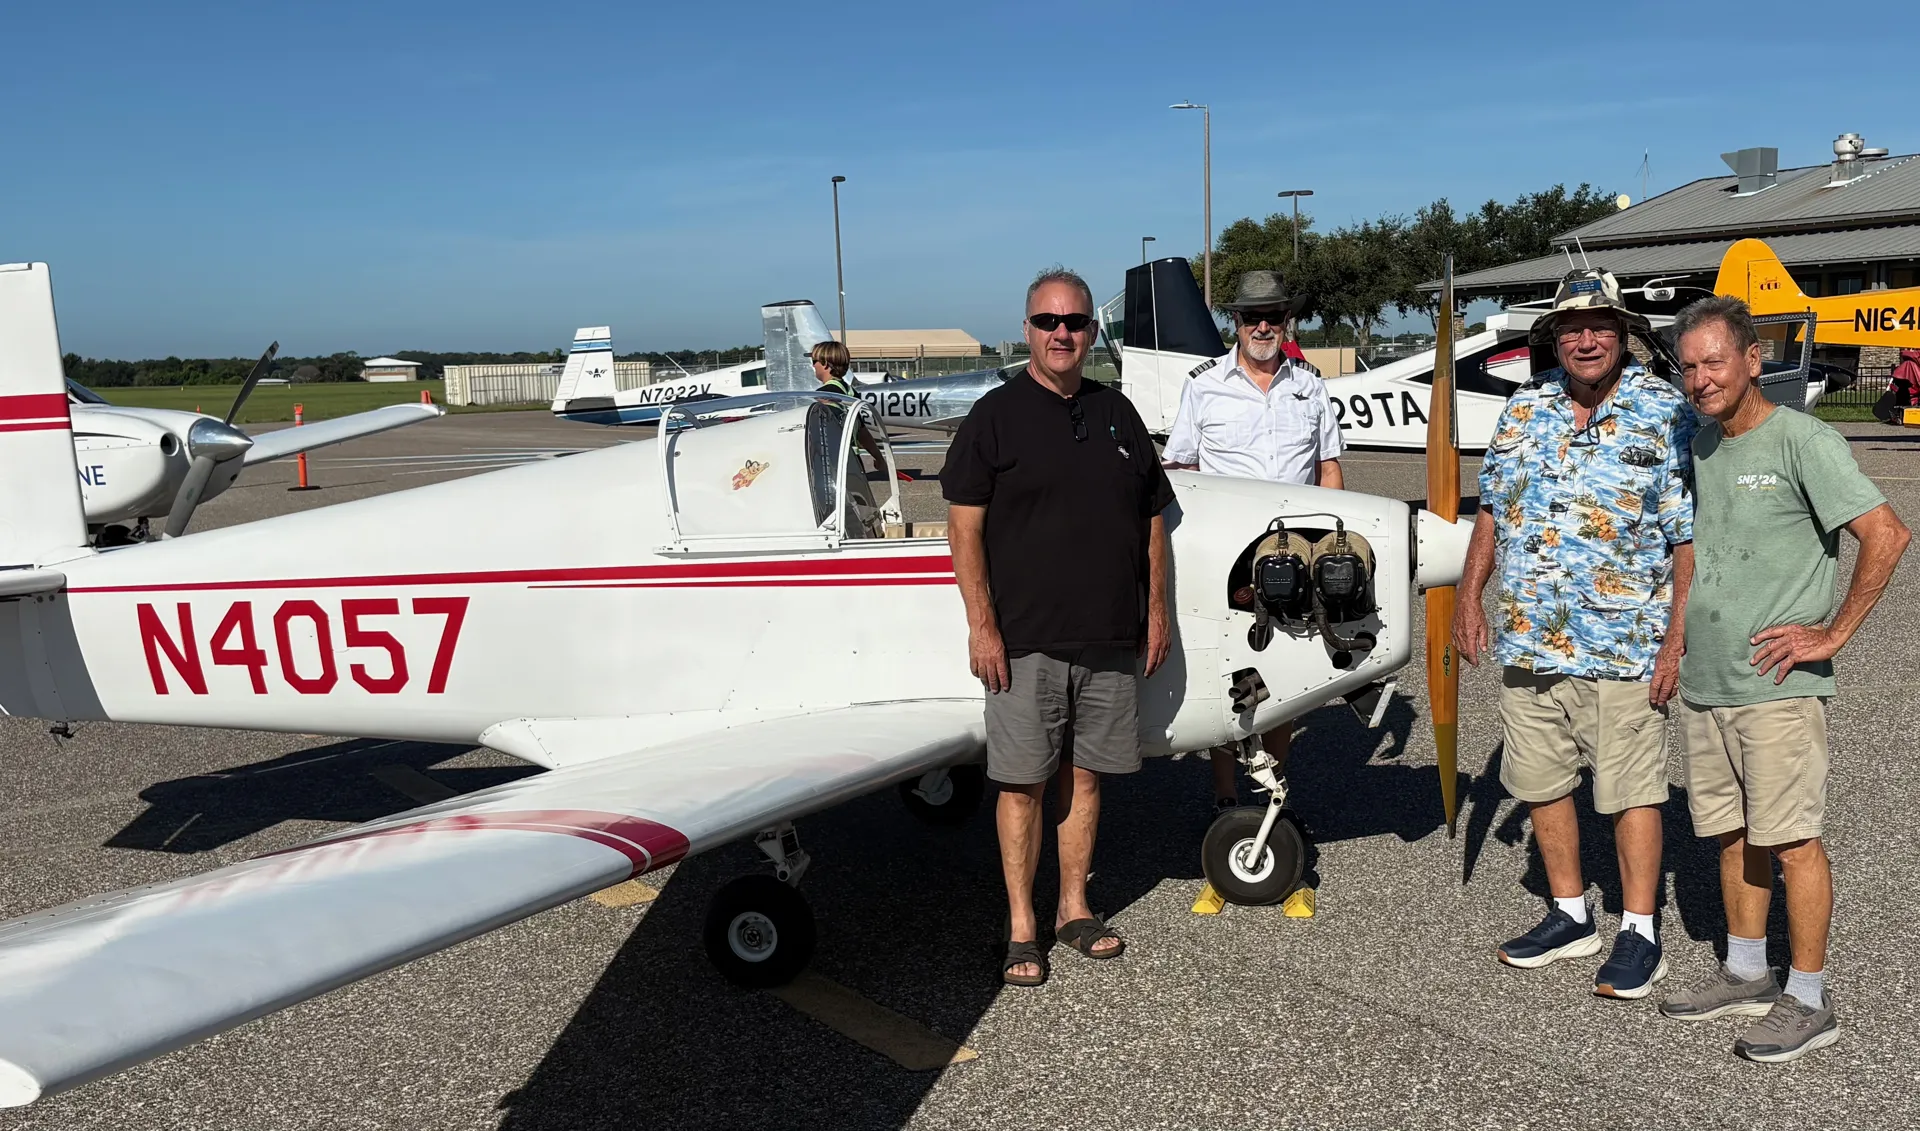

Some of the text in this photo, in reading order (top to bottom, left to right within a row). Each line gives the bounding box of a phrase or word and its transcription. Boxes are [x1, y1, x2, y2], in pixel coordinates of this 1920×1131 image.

[1854, 306, 1920, 332] N164
[640, 383, 711, 403] N7022V
[859, 392, 932, 417] 212GK
[1329, 391, 1428, 430] 29TA
[1737, 474, 1777, 485] SNF '24
[137, 597, 470, 694] N4057
